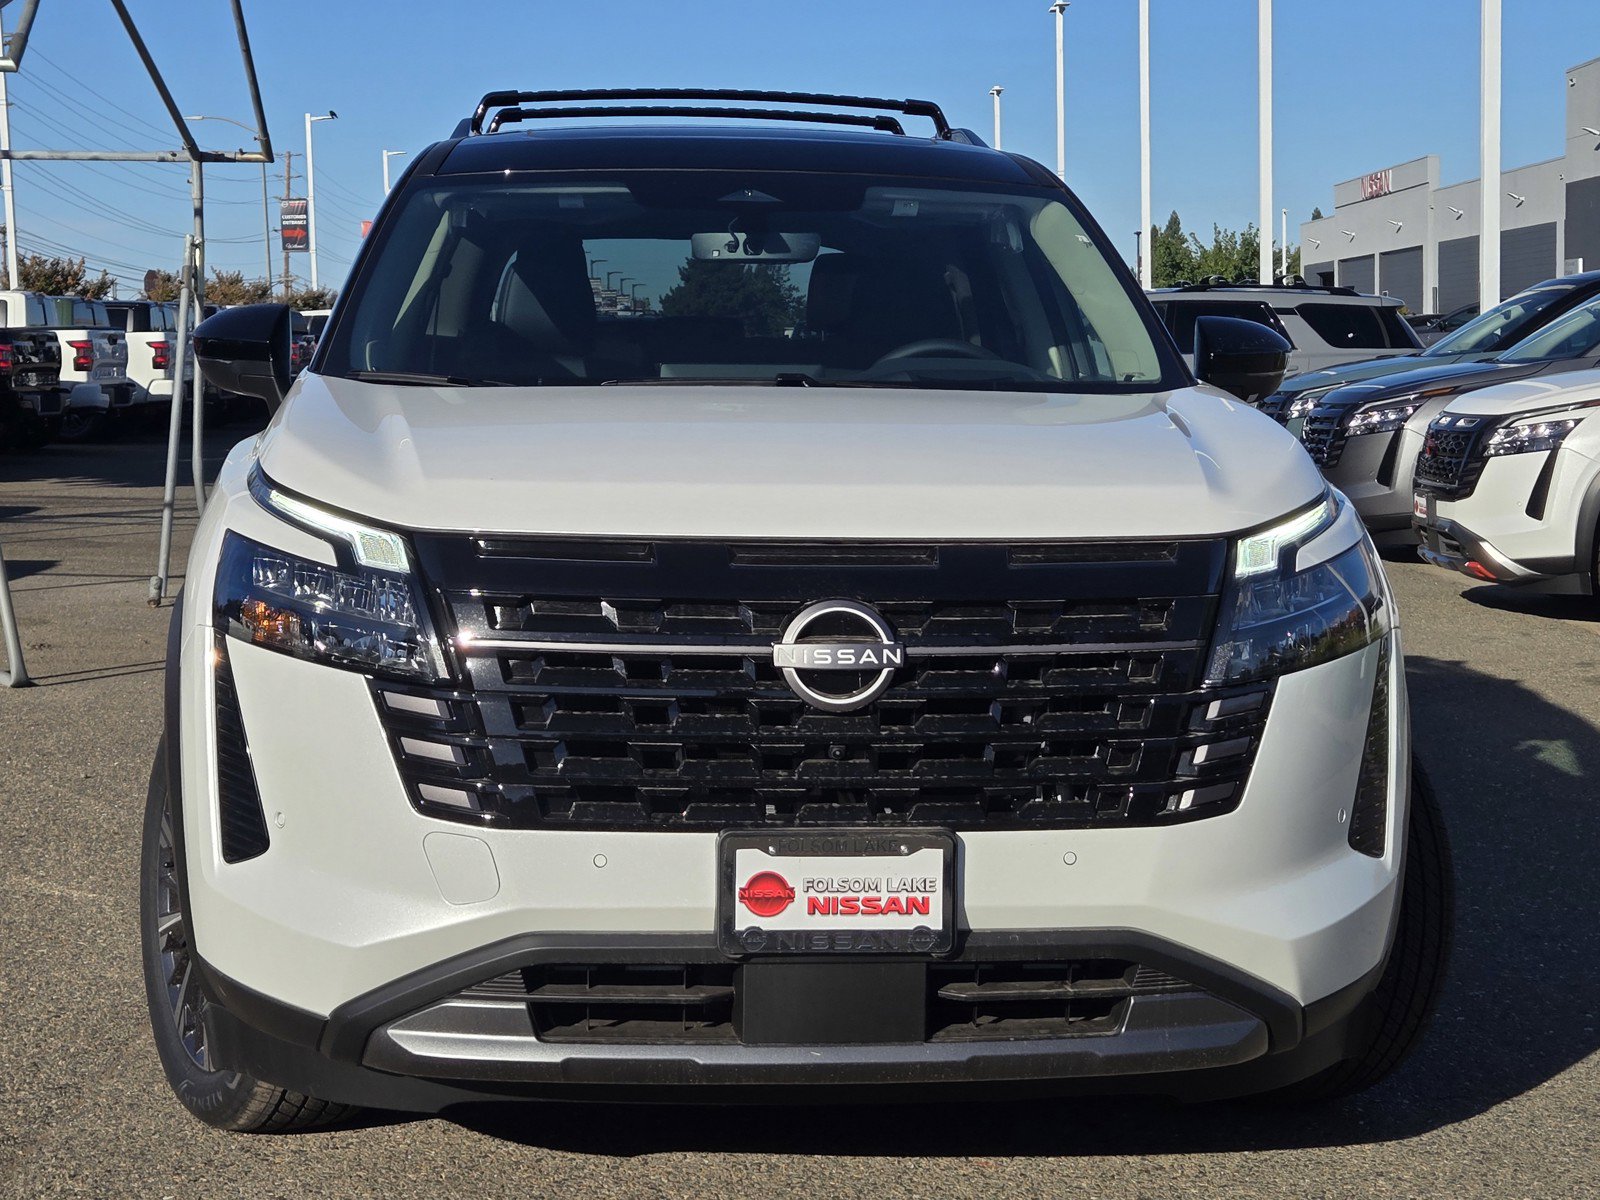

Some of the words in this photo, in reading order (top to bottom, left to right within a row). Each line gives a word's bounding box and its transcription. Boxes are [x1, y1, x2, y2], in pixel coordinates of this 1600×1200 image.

[1360, 168, 1392, 200] NISSAN
[776, 648, 901, 665] NISSAN
[778, 839, 848, 852] FOLSOM
[853, 839, 898, 852] LAKE
[738, 888, 796, 899] NISSAN
[802, 877, 882, 893] FOLSOM
[886, 877, 937, 893] LAKE
[807, 895, 930, 915] NISSAN
[776, 932, 899, 950] NISSAN
